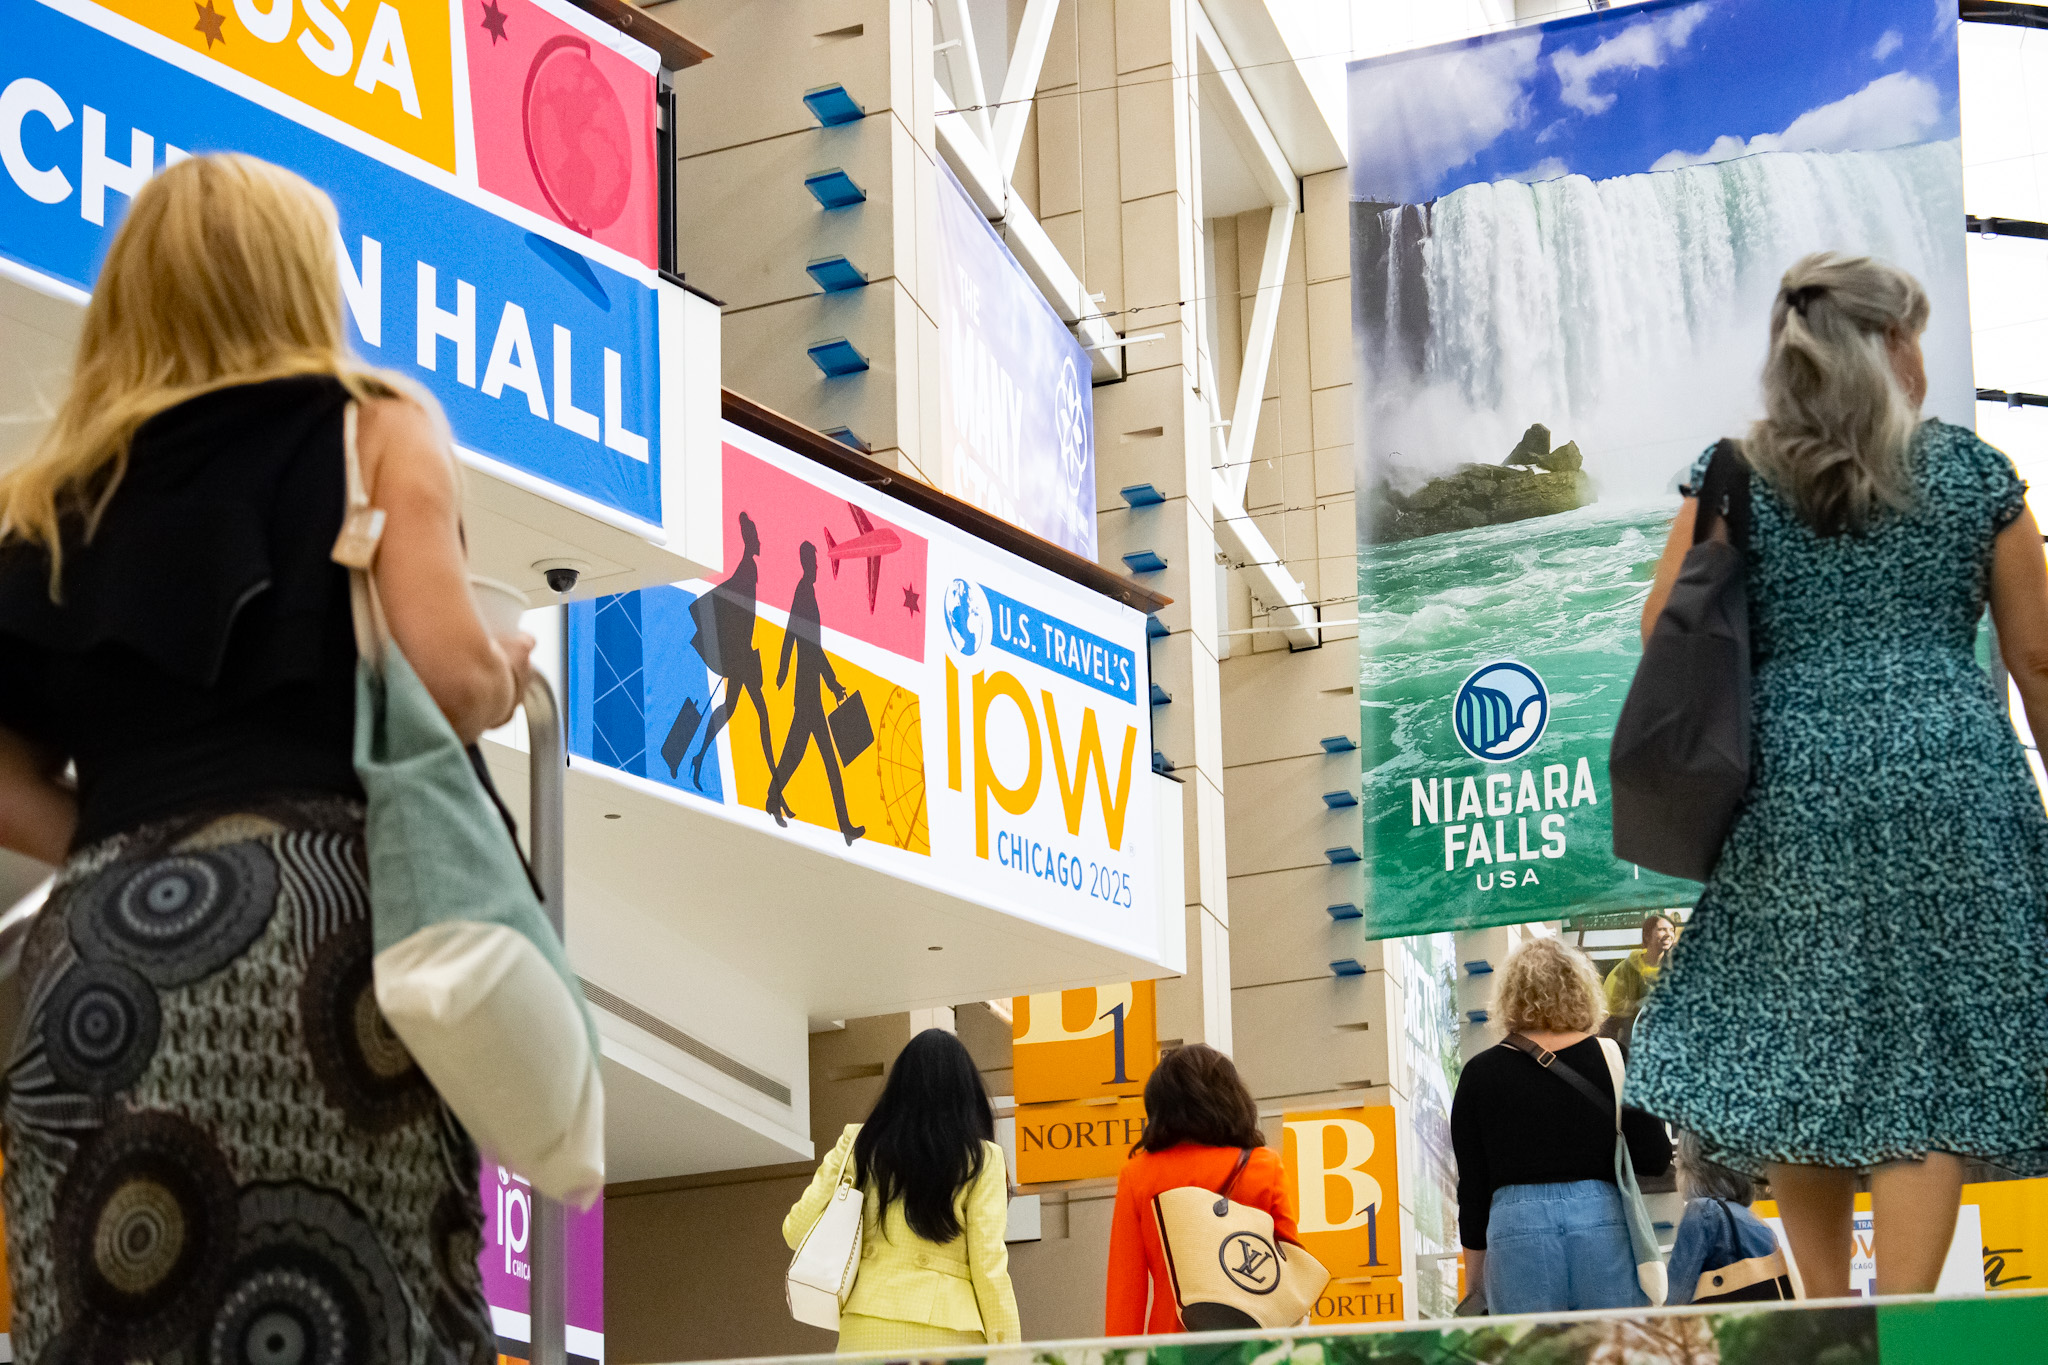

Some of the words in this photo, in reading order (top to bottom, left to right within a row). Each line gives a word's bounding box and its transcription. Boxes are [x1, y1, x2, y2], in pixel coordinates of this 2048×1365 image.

[957, 264, 980, 326] THE
[416, 260, 650, 464] HALL
[952, 306, 1024, 500] MANY
[998, 602, 1036, 654] U.S.
[1042, 622, 1131, 691] TRAVEL'S
[945, 652, 1138, 860] ipw
[1411, 756, 1598, 827] NIAGARA
[997, 831, 1083, 892] CHICAGO
[1090, 861, 1133, 909] 2025
[1444, 813, 1567, 872] FALLS
[1476, 868, 1540, 891] USA
[497, 1184, 531, 1274] ip
[512, 1259, 531, 1281] CHICA
[1309, 1292, 1395, 1319] ORTH
